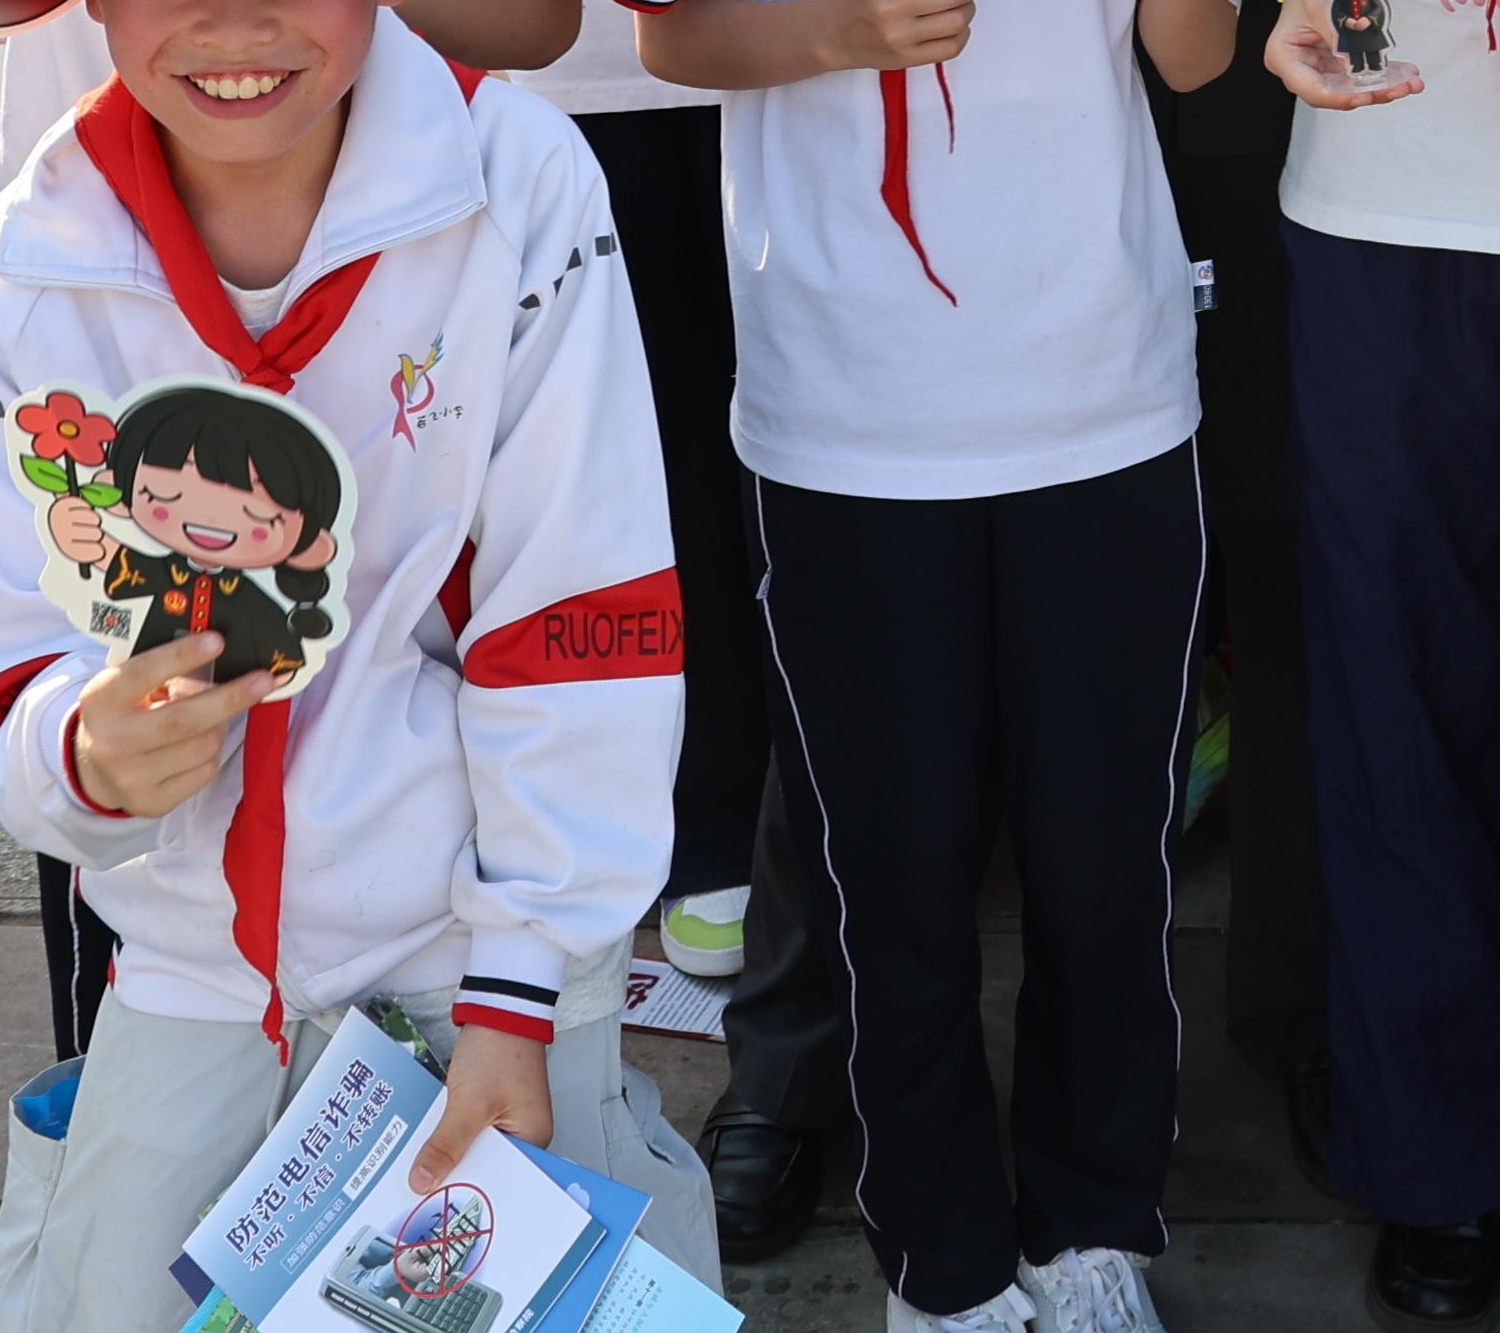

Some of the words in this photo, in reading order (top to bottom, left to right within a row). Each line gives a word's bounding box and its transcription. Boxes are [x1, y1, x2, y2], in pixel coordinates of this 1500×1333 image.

[225, 1059, 375, 1254] 防范电信诈骗
